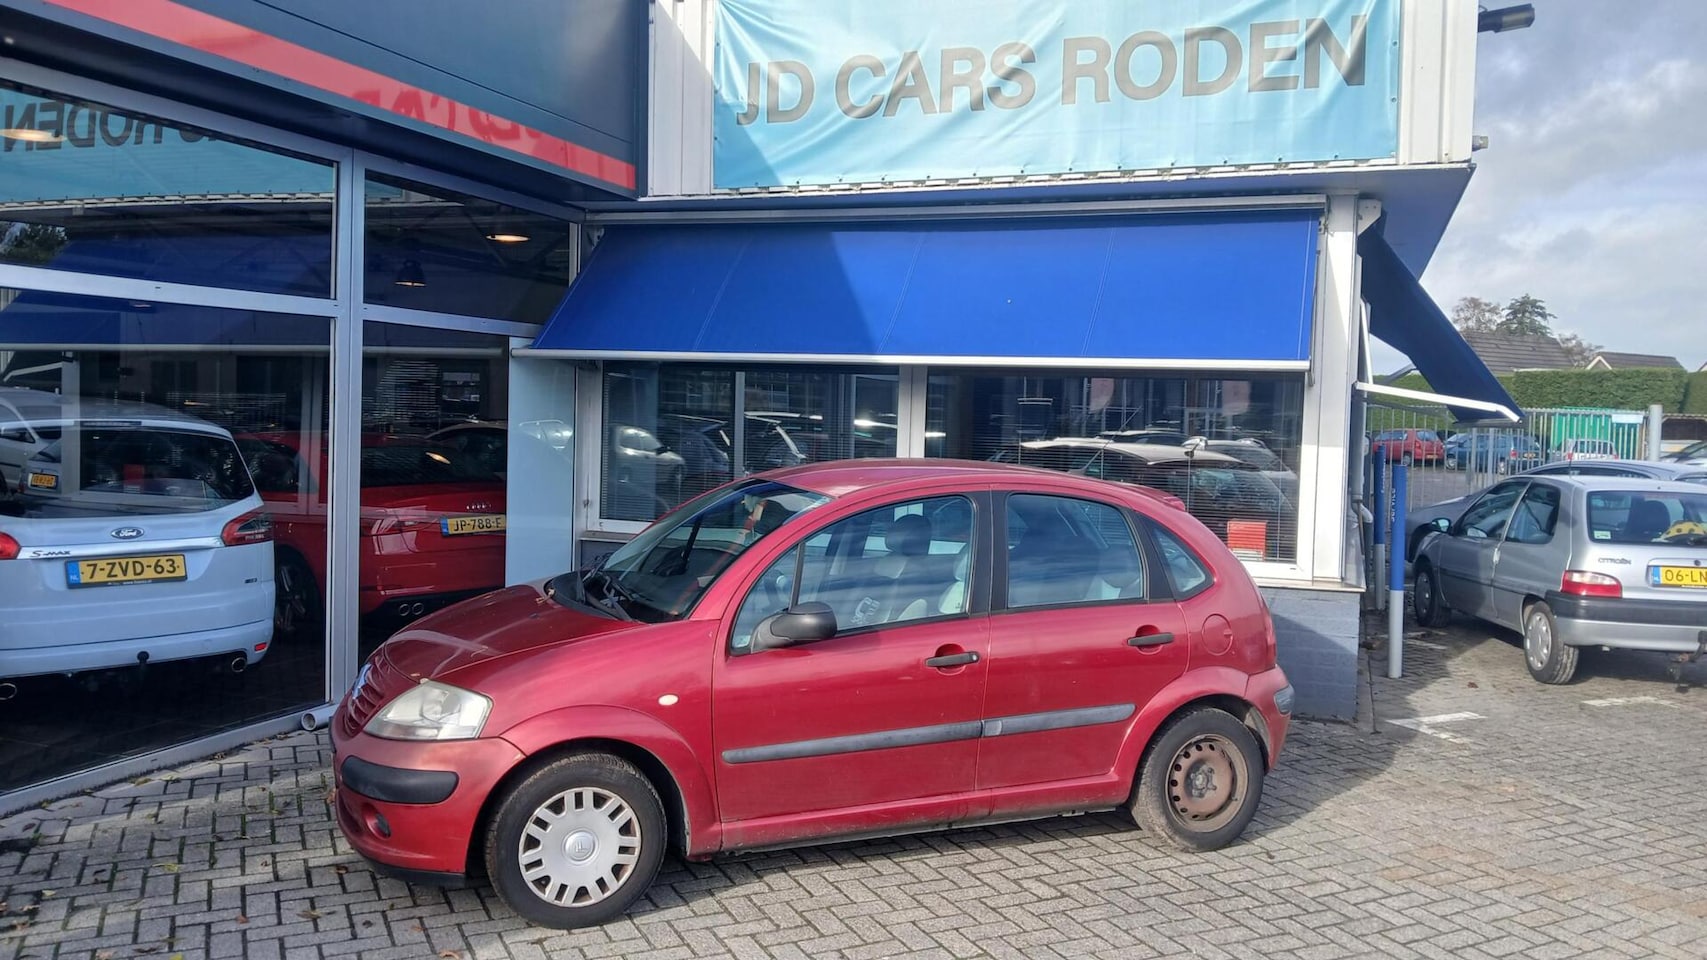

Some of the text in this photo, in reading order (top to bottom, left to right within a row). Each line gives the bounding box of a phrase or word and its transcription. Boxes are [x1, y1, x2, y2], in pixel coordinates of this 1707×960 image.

[737, 14, 1367, 125] JD CARS RODEN
[118, 528, 138, 538] Ford
[32, 550, 71, 559] S-MAX
[86, 558, 177, 580] 7-ZVD-63
